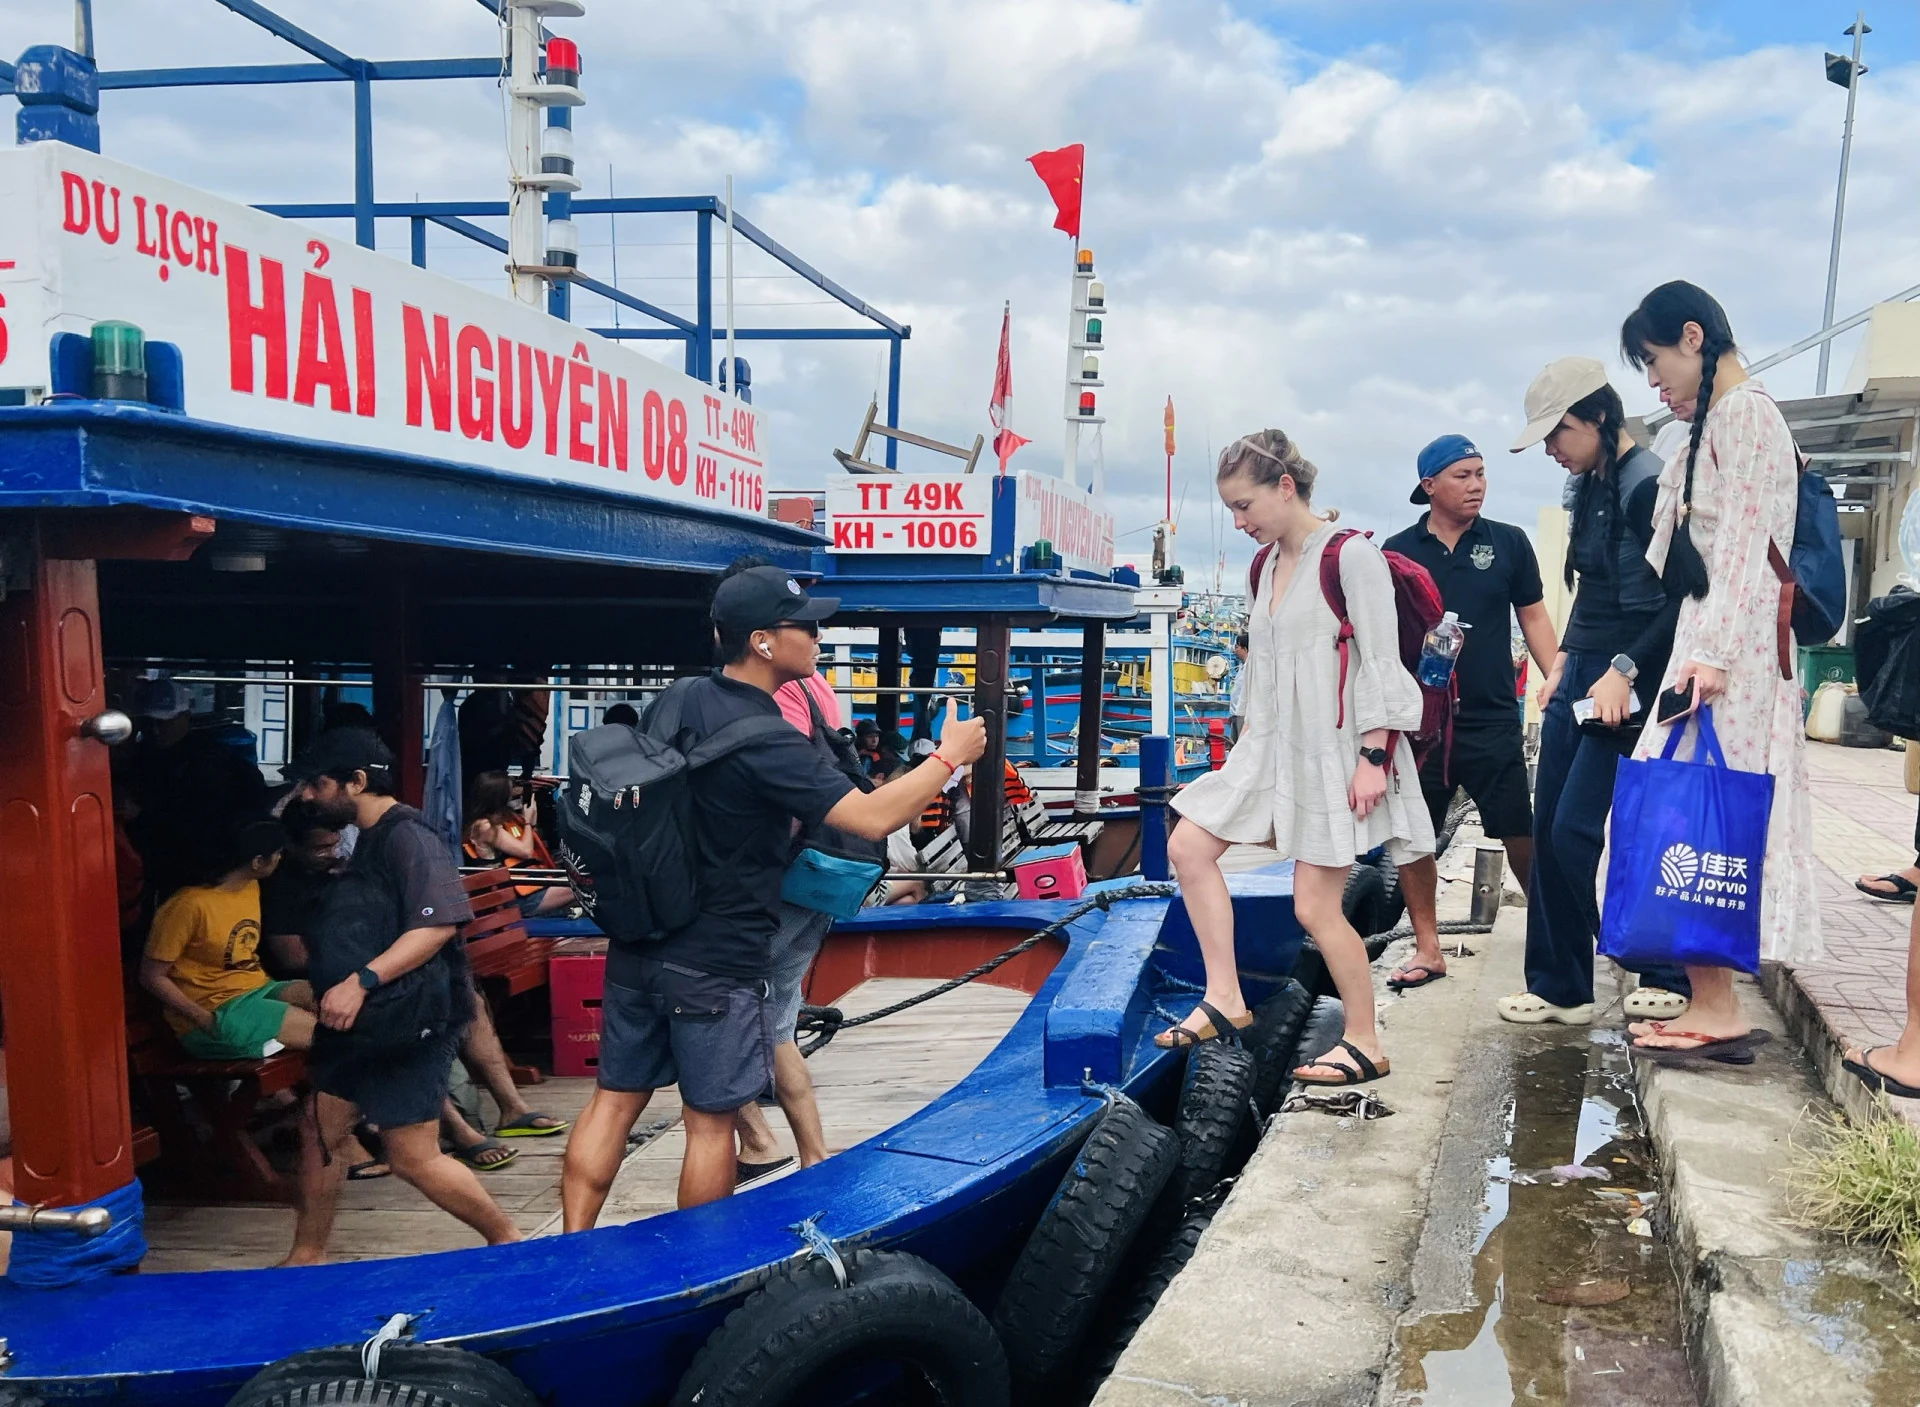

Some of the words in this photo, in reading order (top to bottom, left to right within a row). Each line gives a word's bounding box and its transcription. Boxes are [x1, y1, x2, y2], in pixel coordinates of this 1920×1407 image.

[61, 170, 121, 245] DU
[133, 196, 220, 282] LỊCH
[225, 239, 376, 418] HẢI
[403, 303, 628, 473] NGUYÊN
[643, 389, 688, 486] 08
[857, 482, 893, 510] TT
[904, 482, 964, 511] 49K
[1701, 852, 1747, 879] 佳沃
[1696, 877, 1747, 895] JOYVIO
